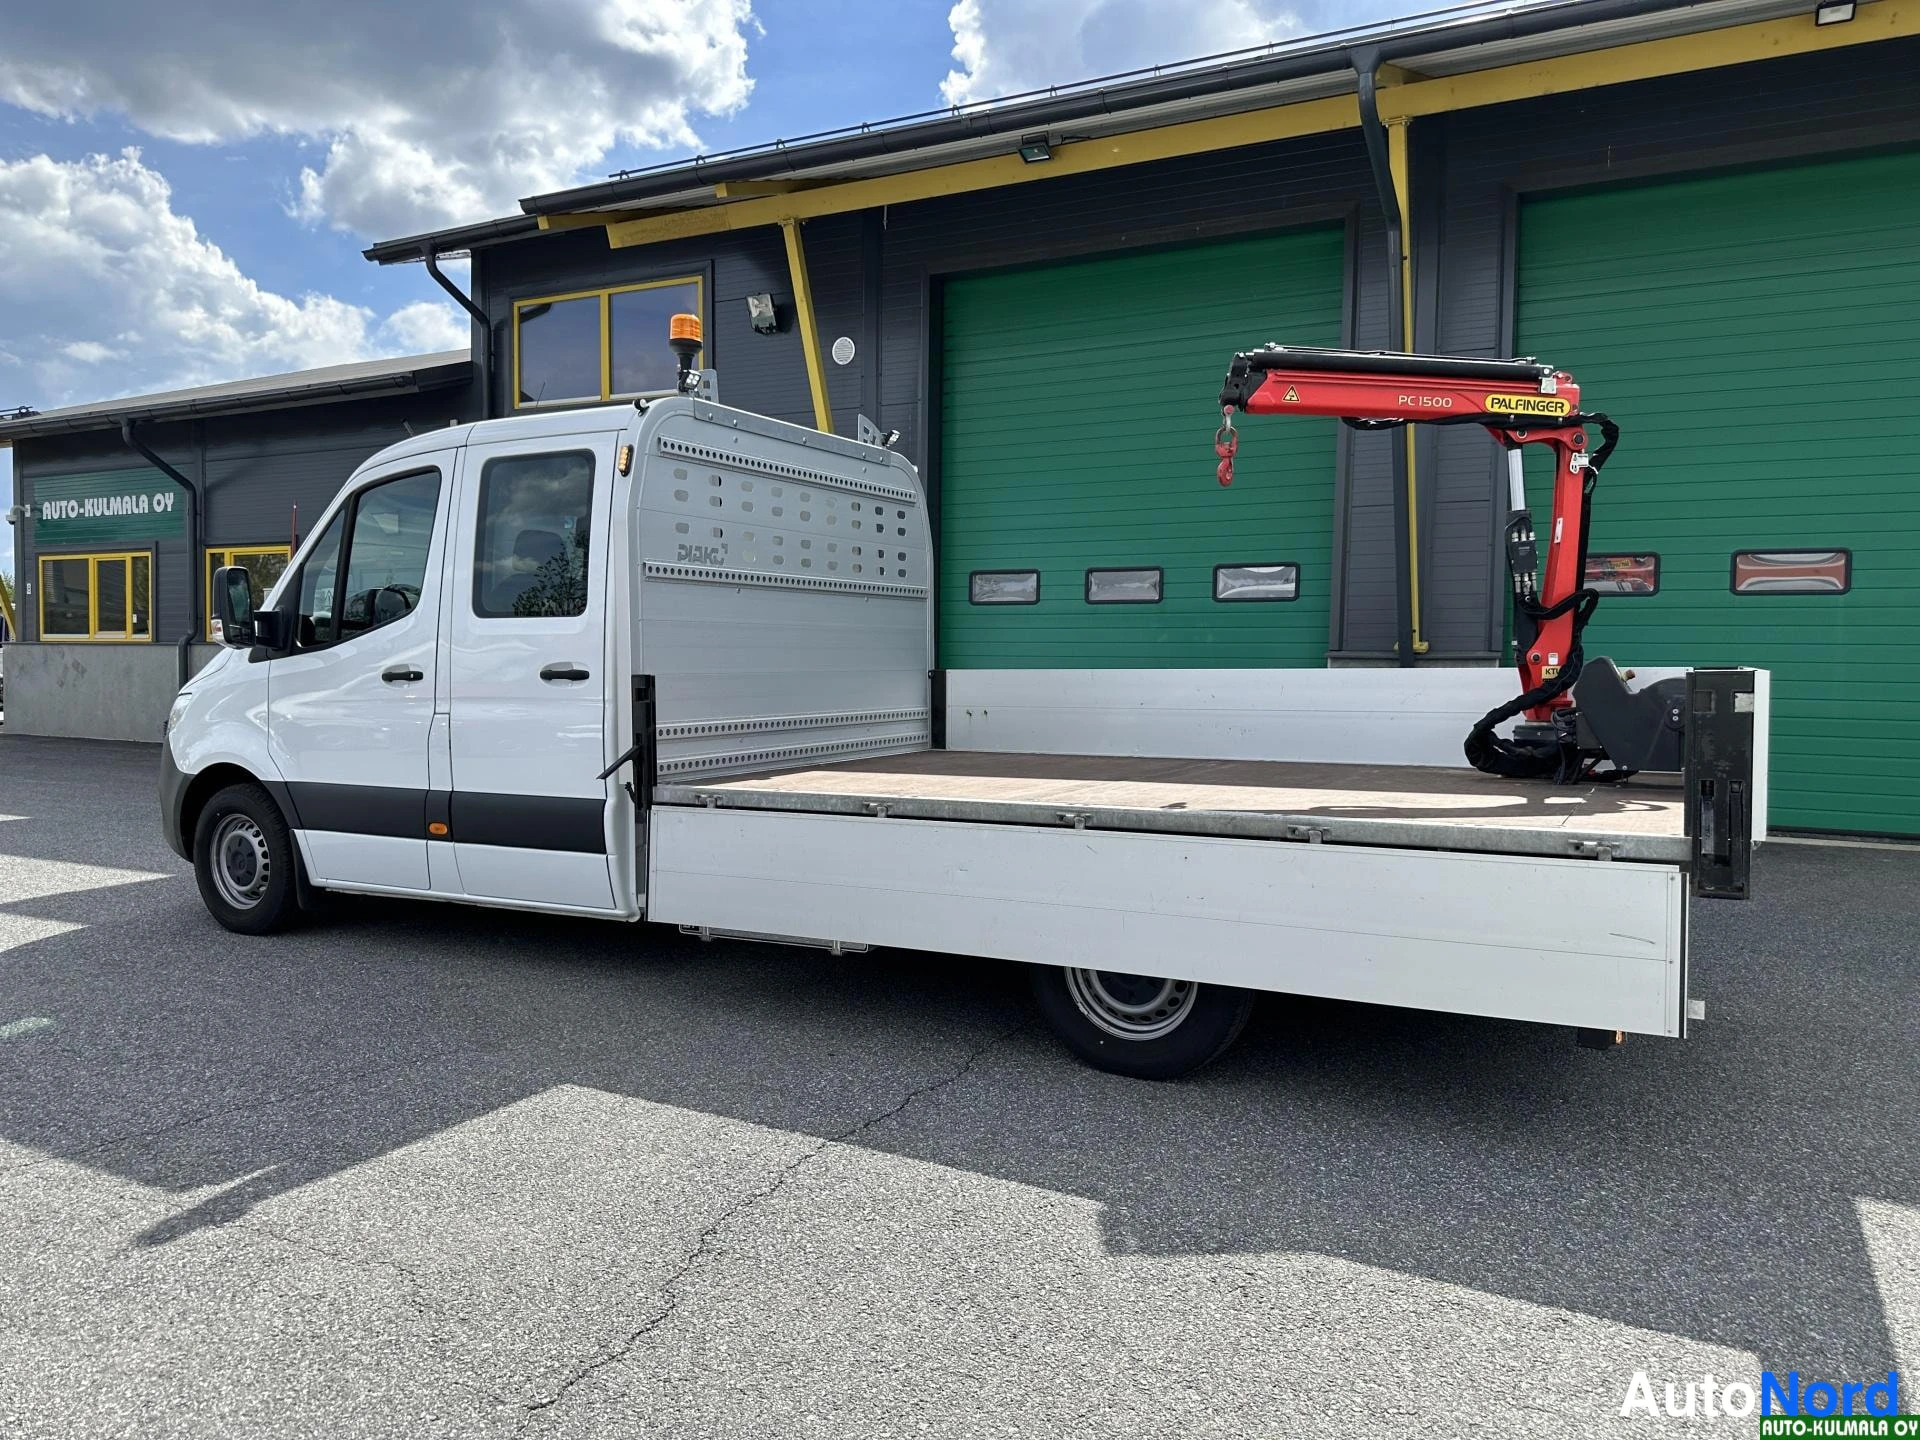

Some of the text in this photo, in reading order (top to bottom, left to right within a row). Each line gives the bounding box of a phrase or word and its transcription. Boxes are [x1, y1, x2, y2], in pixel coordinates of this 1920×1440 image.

[1398, 395, 1453, 408] PC 1500
[1490, 397, 1565, 413] PALFINGER
[42, 492, 174, 520] AUTO-KULMALA OY
